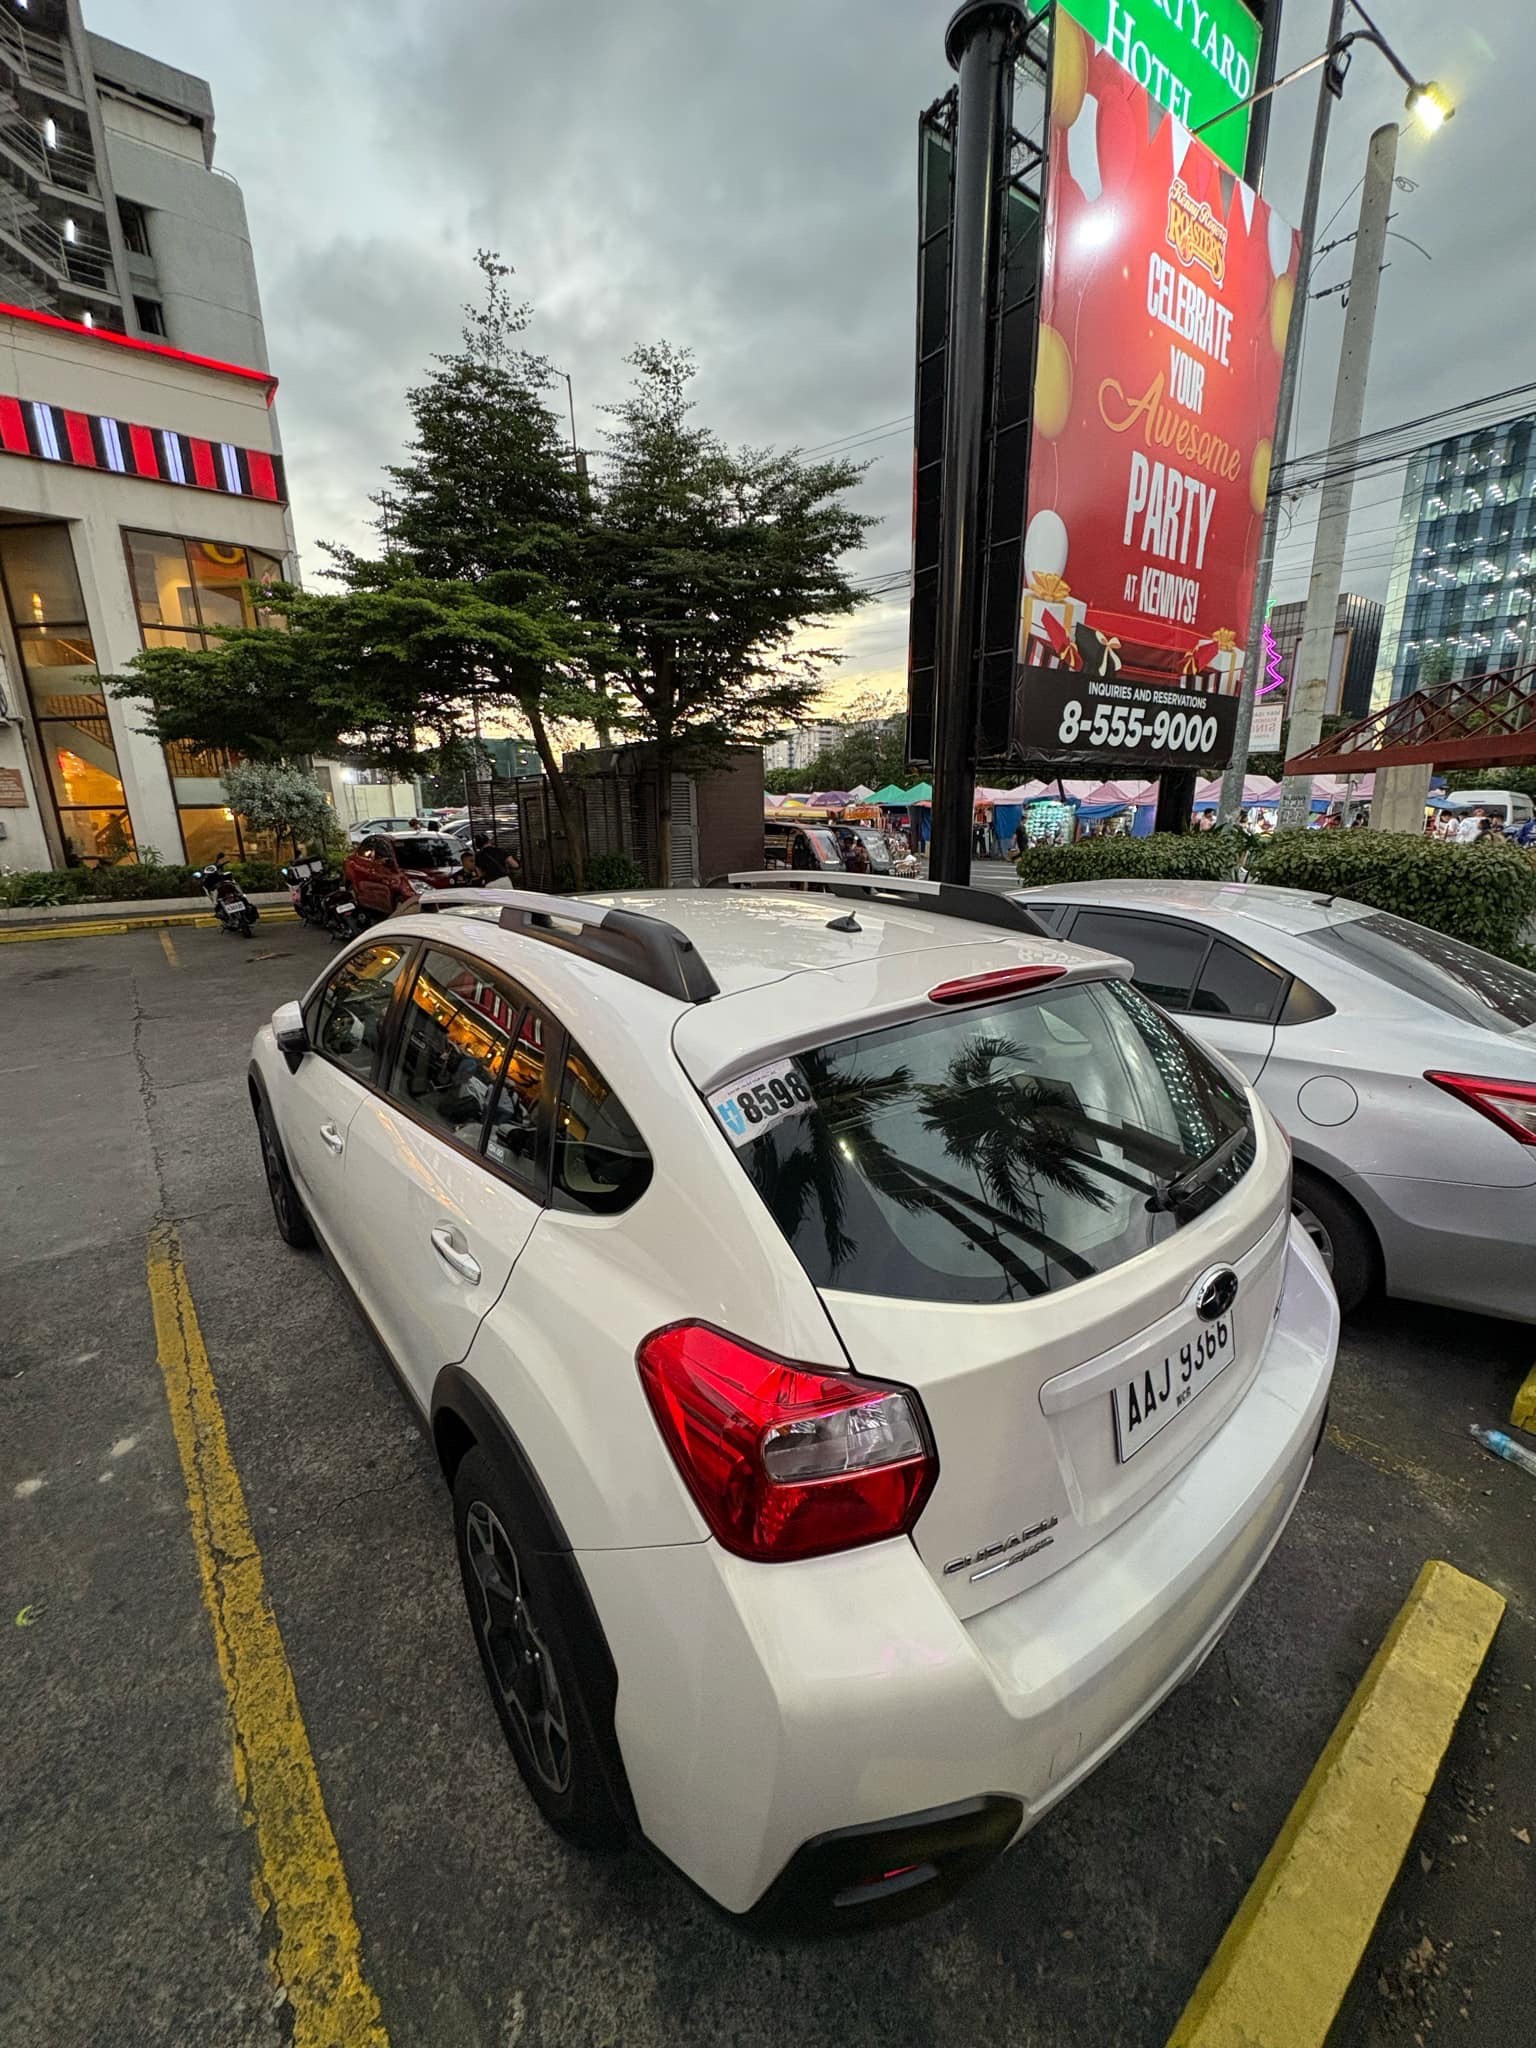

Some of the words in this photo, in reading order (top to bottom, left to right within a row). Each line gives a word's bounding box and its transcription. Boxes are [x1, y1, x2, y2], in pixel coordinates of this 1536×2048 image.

[1104, 0, 1193, 132] HOTEL
[1169, 200, 1224, 281] ROASTERS
[1170, 181, 1200, 220] Kenny
[1200, 205, 1227, 244] Rogers
[1147, 252, 1233, 367] CELEBRATE
[1169, 344, 1205, 415] YOUR
[1098, 370, 1241, 482] Awesome
[1123, 450, 1217, 569] PARTY
[1124, 573, 1138, 602] AT
[1138, 565, 1200, 625] KENNYS!
[1058, 700, 1218, 753] 8-555-9000
[1088, 681, 1132, 700] INQUIRIES
[1133, 688, 1152, 702] AND
[1152, 692, 1207, 709] RESERVATIONS
[736, 1072, 811, 1124] 8598
[1128, 1357, 1171, 1432] AAJ
